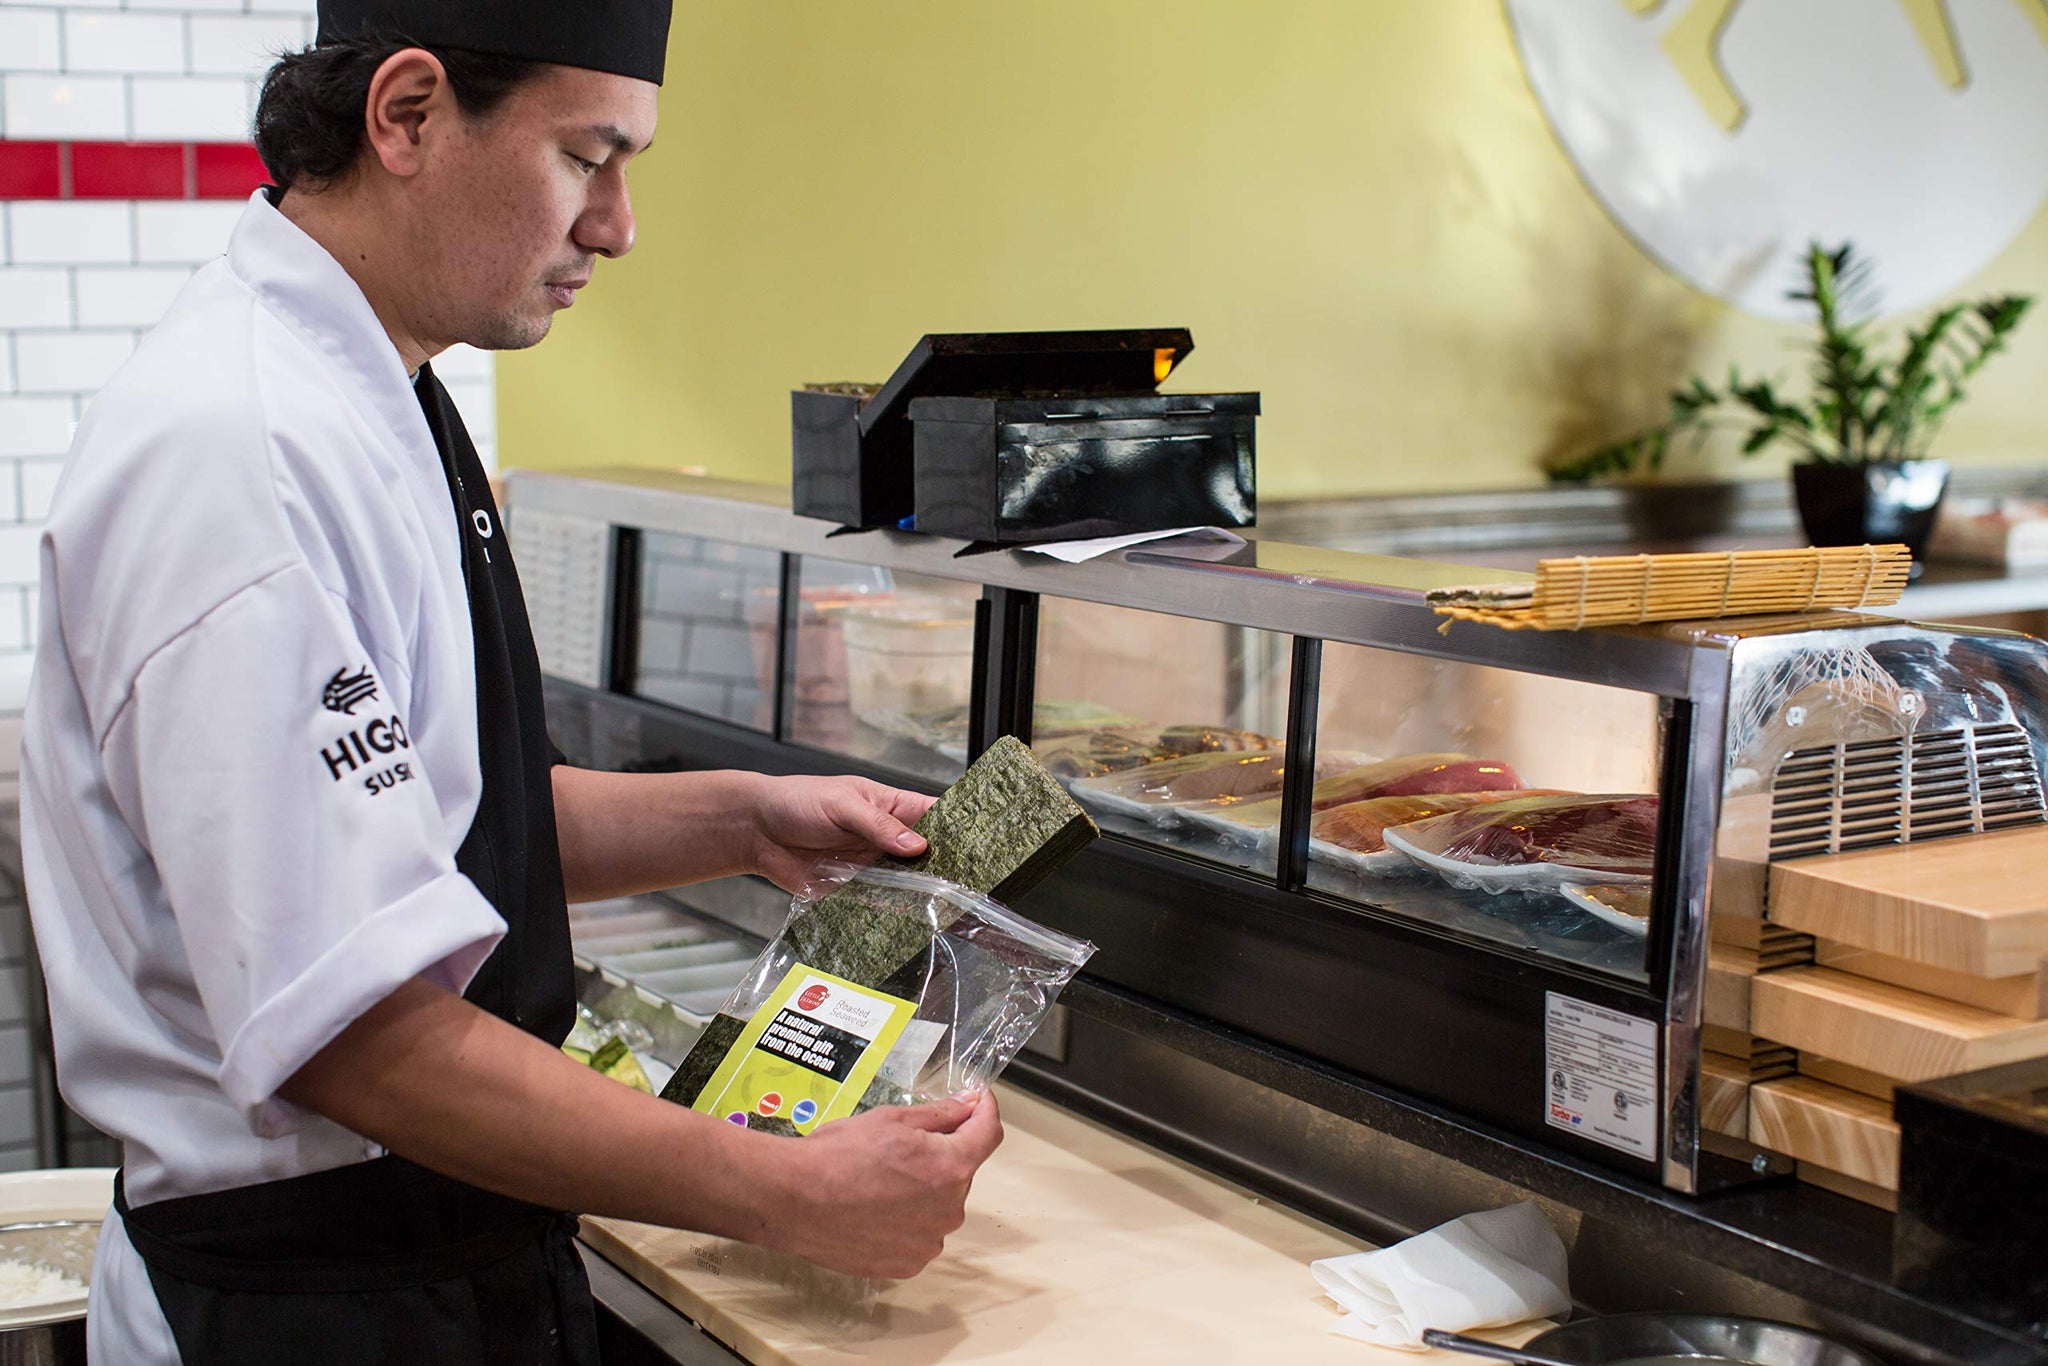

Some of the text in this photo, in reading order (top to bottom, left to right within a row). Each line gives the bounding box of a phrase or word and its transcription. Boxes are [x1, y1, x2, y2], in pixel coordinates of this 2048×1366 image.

[320, 714, 409, 781] HIGO
[805, 990, 821, 1000] LITTLE
[836, 999, 871, 1018] Roasted
[775, 1010, 825, 1037] A natural
[830, 1008, 869, 1027] Seaweed
[760, 1032, 836, 1072] from the ocean
[767, 1023, 834, 1056] premium gift
